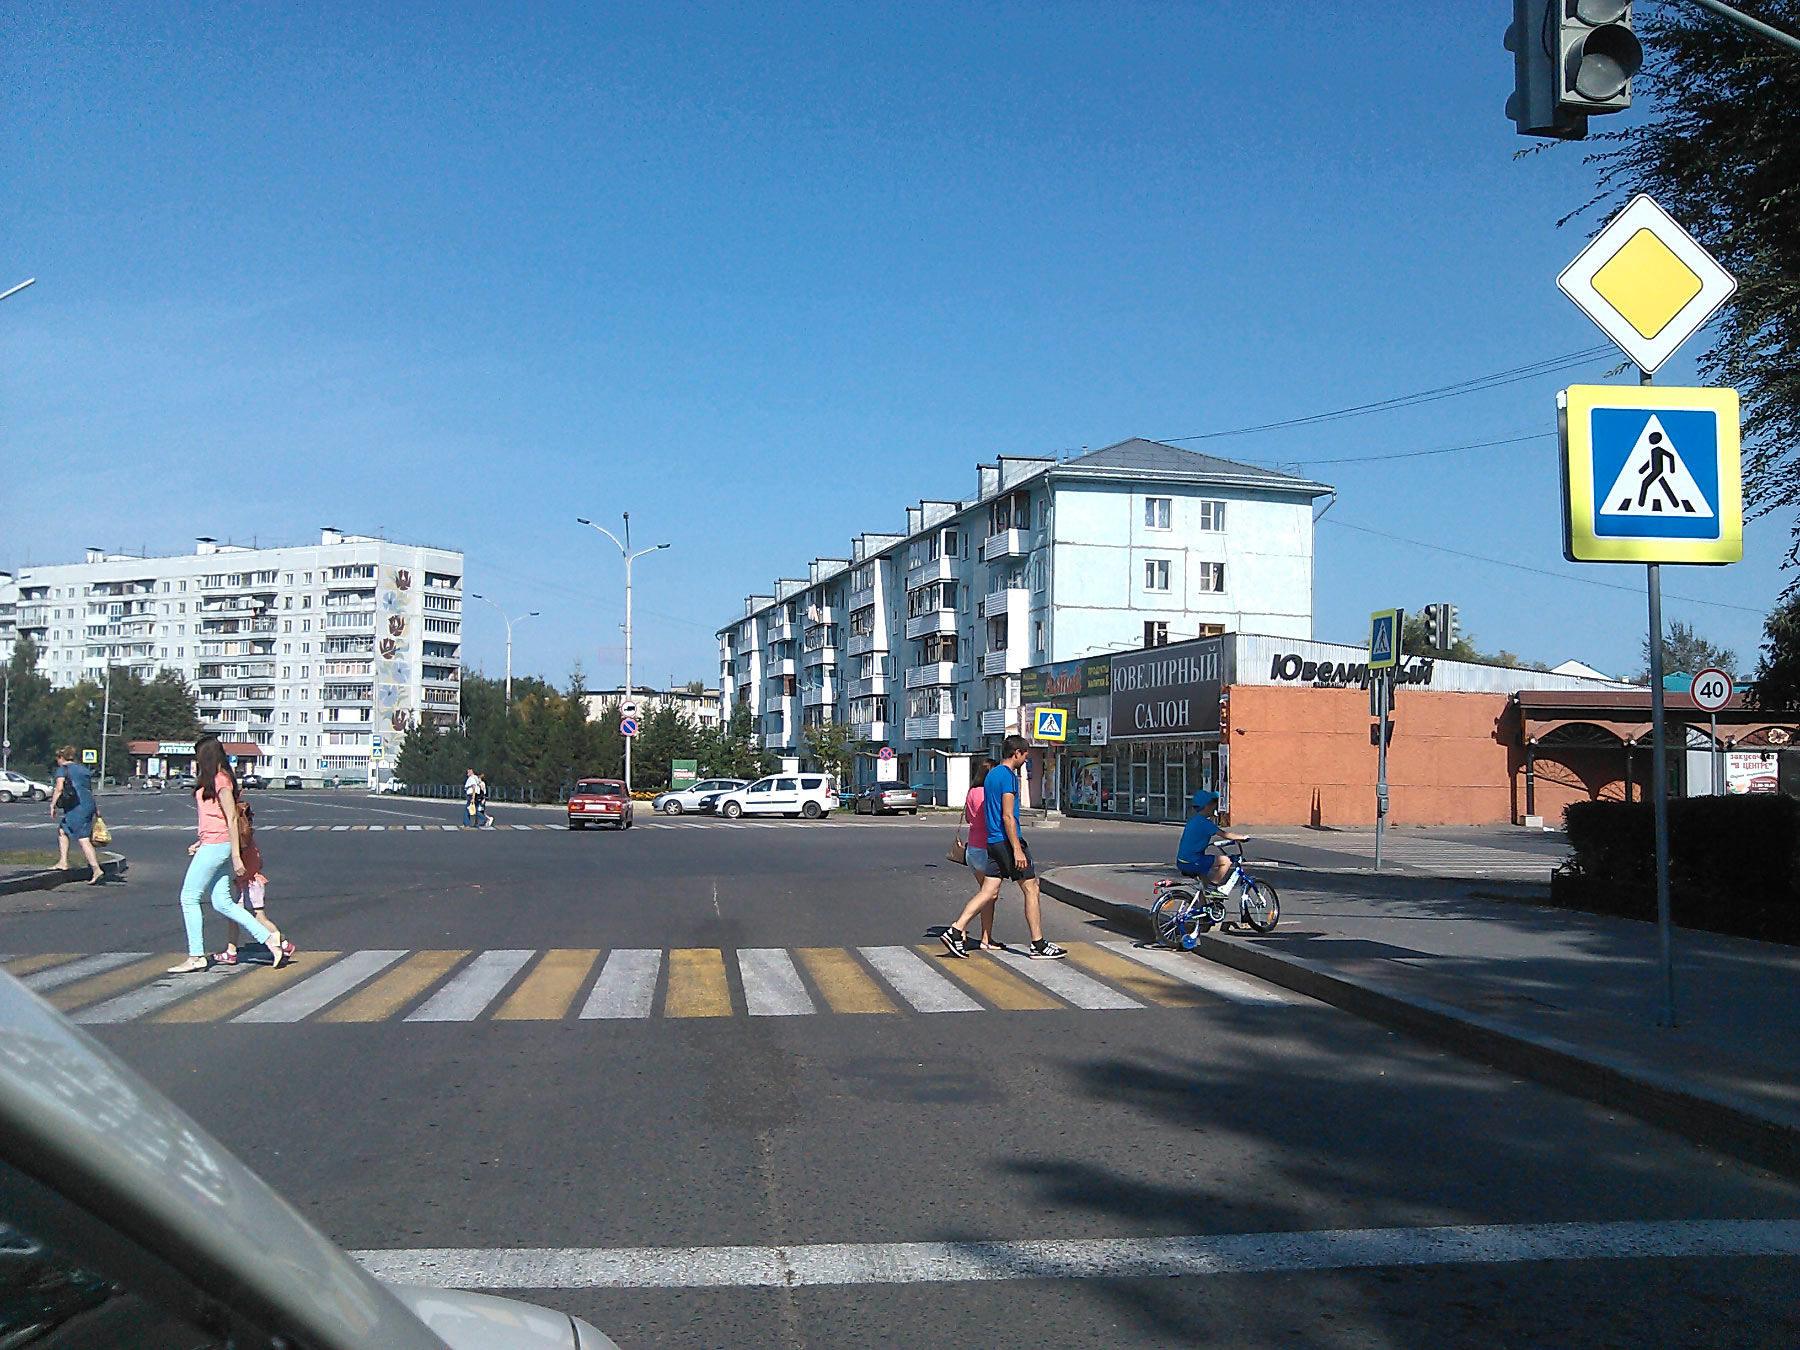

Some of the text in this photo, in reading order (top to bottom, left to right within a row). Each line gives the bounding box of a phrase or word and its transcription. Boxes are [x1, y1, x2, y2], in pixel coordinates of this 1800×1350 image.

[1112, 645, 1219, 692] ЮВЕЛИРНЫЙ
[1270, 653, 1434, 690] Ювелирый
[1700, 681, 1724, 698] 40
[1134, 699, 1190, 729] САЛОН
[158, 746, 196, 754] АПТЕКА
